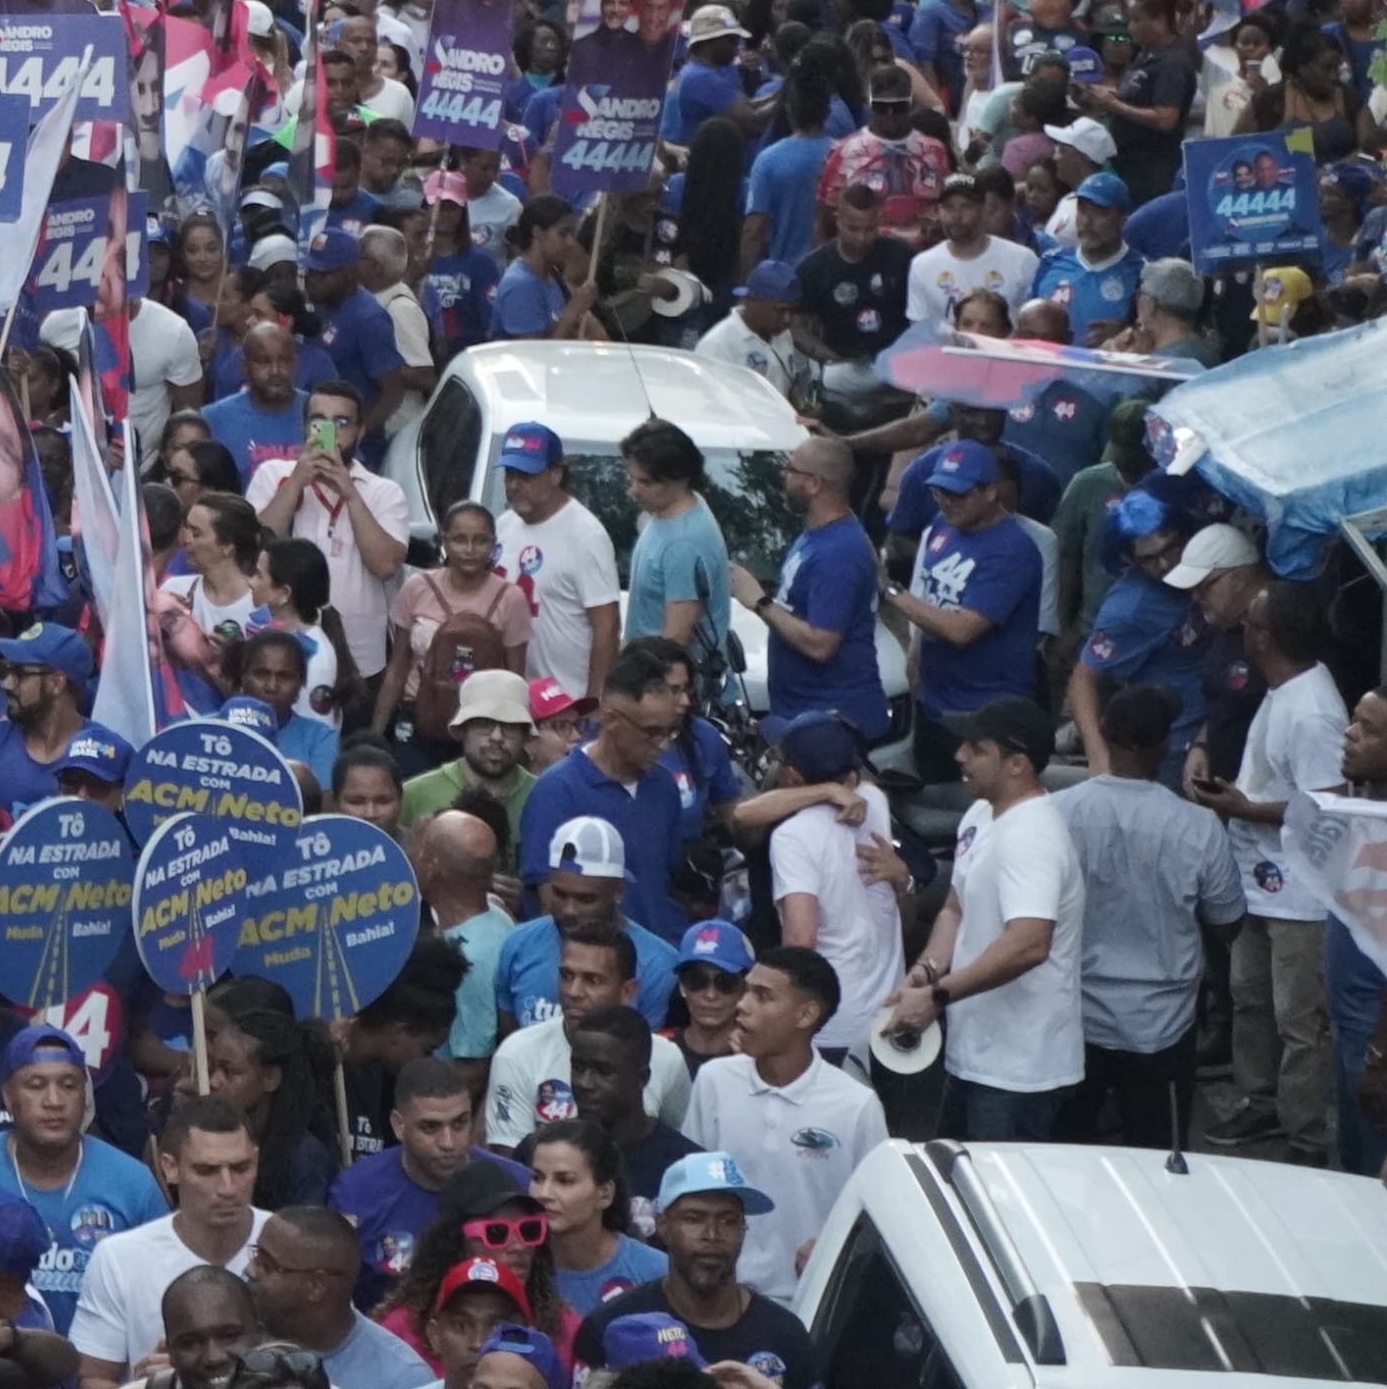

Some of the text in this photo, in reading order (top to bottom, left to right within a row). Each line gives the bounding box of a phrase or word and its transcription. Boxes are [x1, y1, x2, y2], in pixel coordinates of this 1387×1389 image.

[421, 94, 502, 130] 44444
[560, 139, 655, 175] 44444
[1215, 187, 1297, 217] 44444
[200, 731, 233, 757] TÔ
[146, 748, 281, 786] NA ESTRADA
[200, 774, 232, 791] COM
[125, 778, 302, 827] ACM Neto
[58, 812, 85, 839] TÔ
[173, 824, 196, 852] TÔ
[7, 840, 121, 866] NA ESTRADA
[294, 831, 332, 861] TÔ
[53, 866, 80, 880] COM
[145, 834, 230, 889] NA ESTRADA
[245, 844, 387, 899] NA ESTRADA
[179, 870, 202, 887] COM
[305, 882, 338, 900] COM
[65, 880, 131, 910] Neto
[139, 867, 248, 938] ACM Neto
[236, 881, 416, 948] ACM Neto
[539, 1101, 577, 1120] 44
